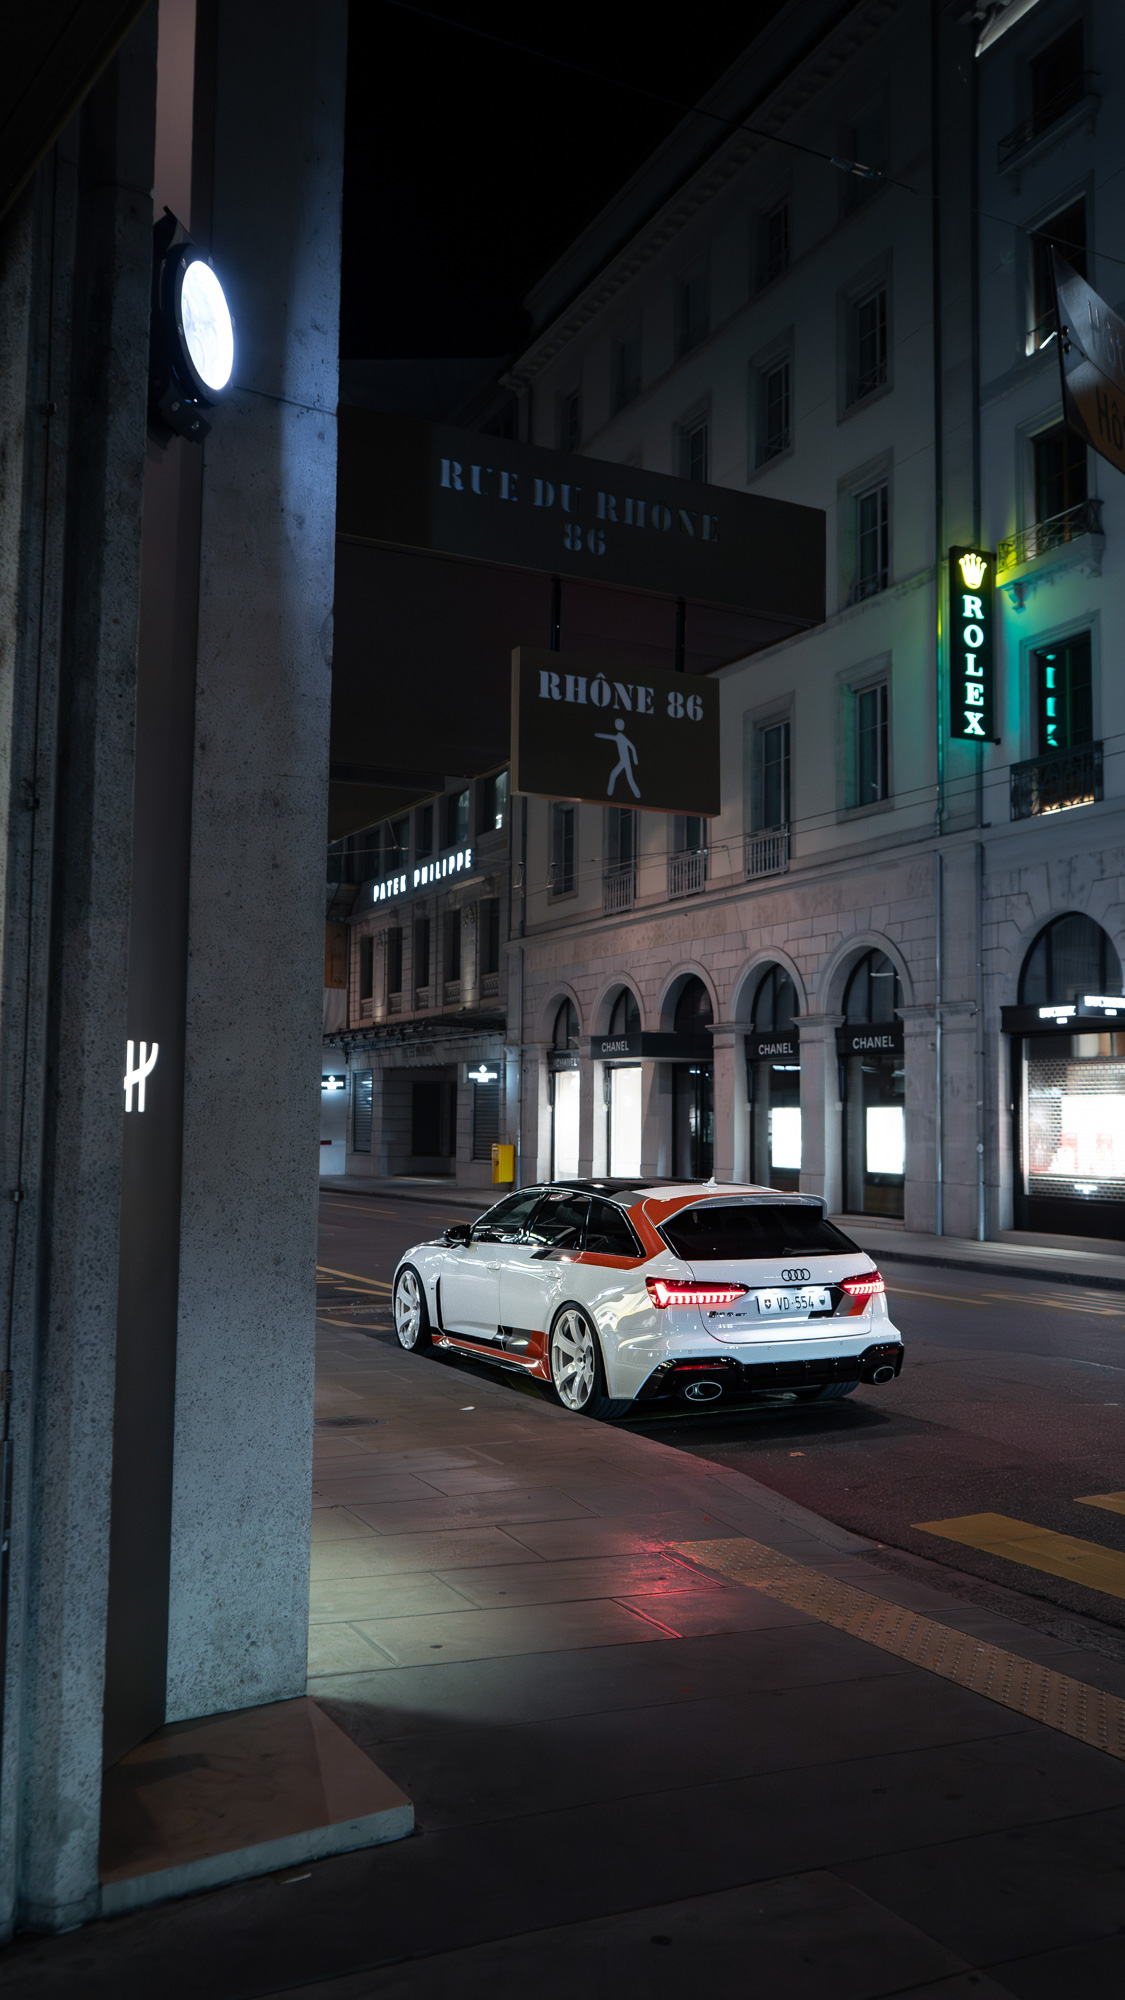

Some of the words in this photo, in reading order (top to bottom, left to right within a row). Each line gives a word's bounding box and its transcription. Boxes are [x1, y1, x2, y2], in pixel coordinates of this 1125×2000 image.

[439, 458, 518, 501] RUE
[533, 478, 582, 514] DU
[563, 522, 606, 556] 86
[962, 594, 985, 736] ROLEX
[538, 670, 655, 715] RHÔNE
[667, 691, 704, 722] 86
[373, 874, 407, 903] PATEK
[413, 848, 472, 888] PHILIPPE
[601, 1040, 630, 1053] CHANEL
[758, 1042, 794, 1055] CHANEL
[852, 1035, 895, 1050] CHANEL
